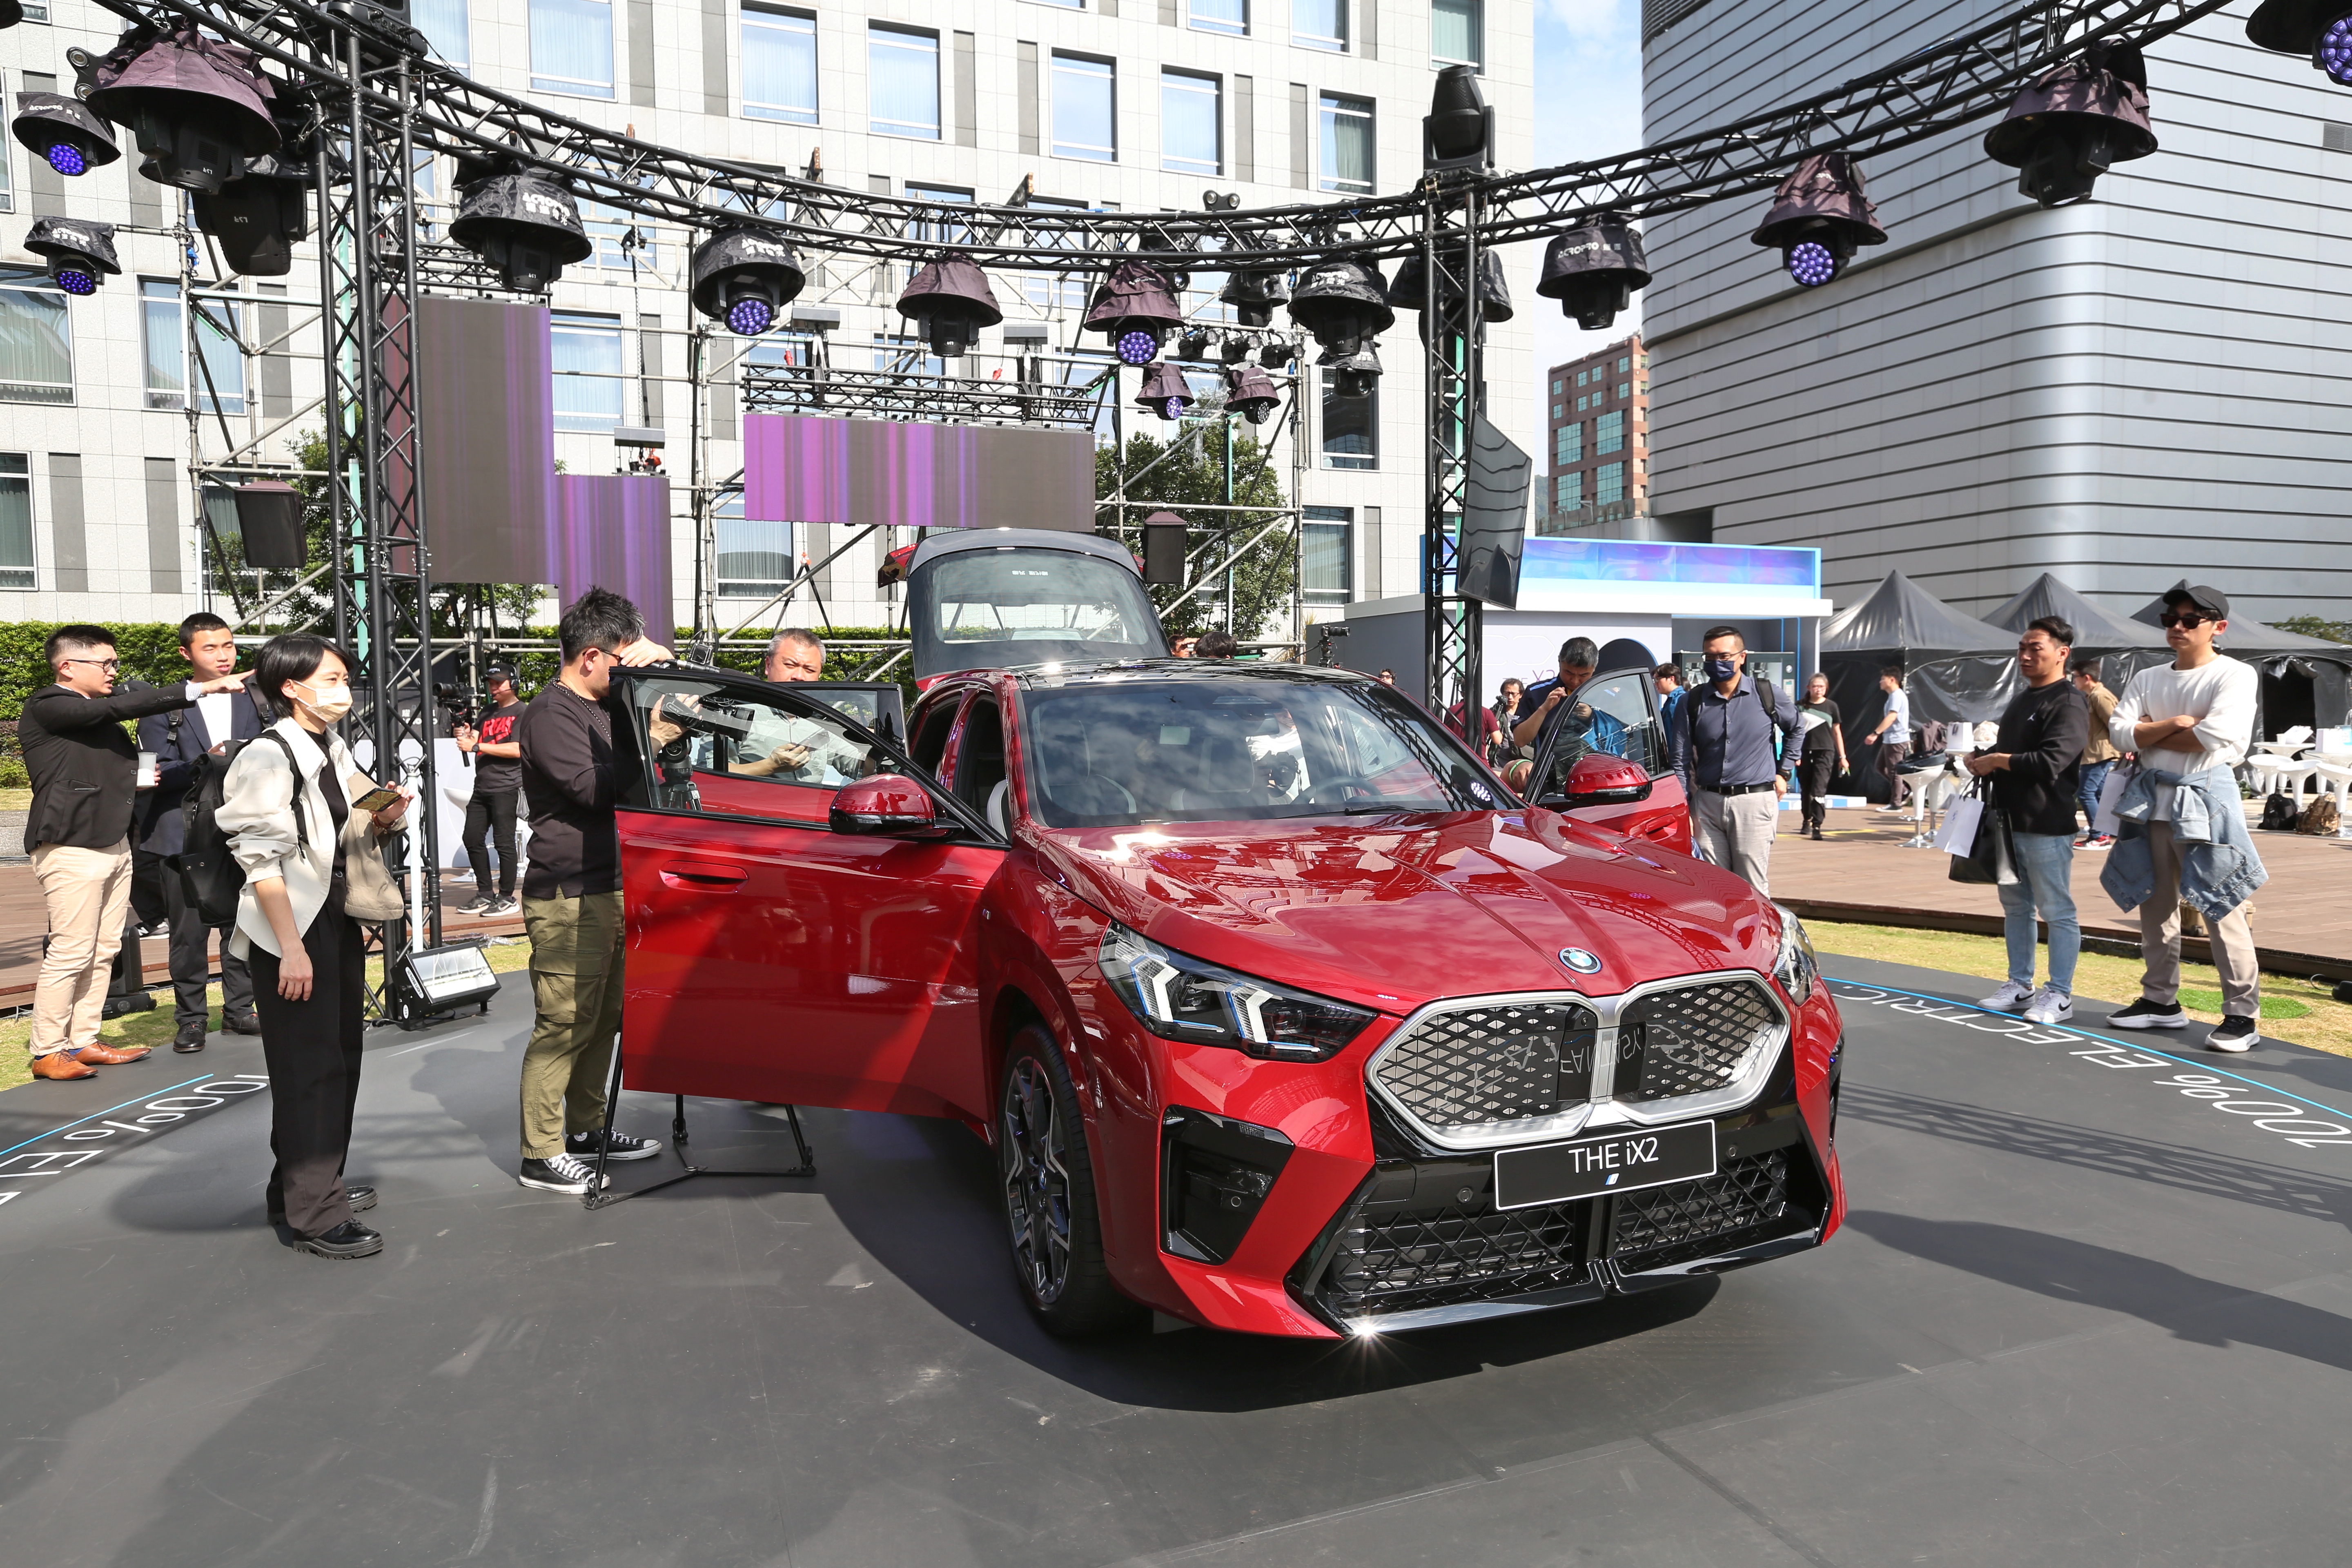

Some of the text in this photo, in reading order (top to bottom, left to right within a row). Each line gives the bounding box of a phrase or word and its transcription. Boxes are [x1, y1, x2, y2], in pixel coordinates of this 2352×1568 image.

[669, 705, 680, 713] SONY
[1567, 1137, 1659, 1174] THE iX2
